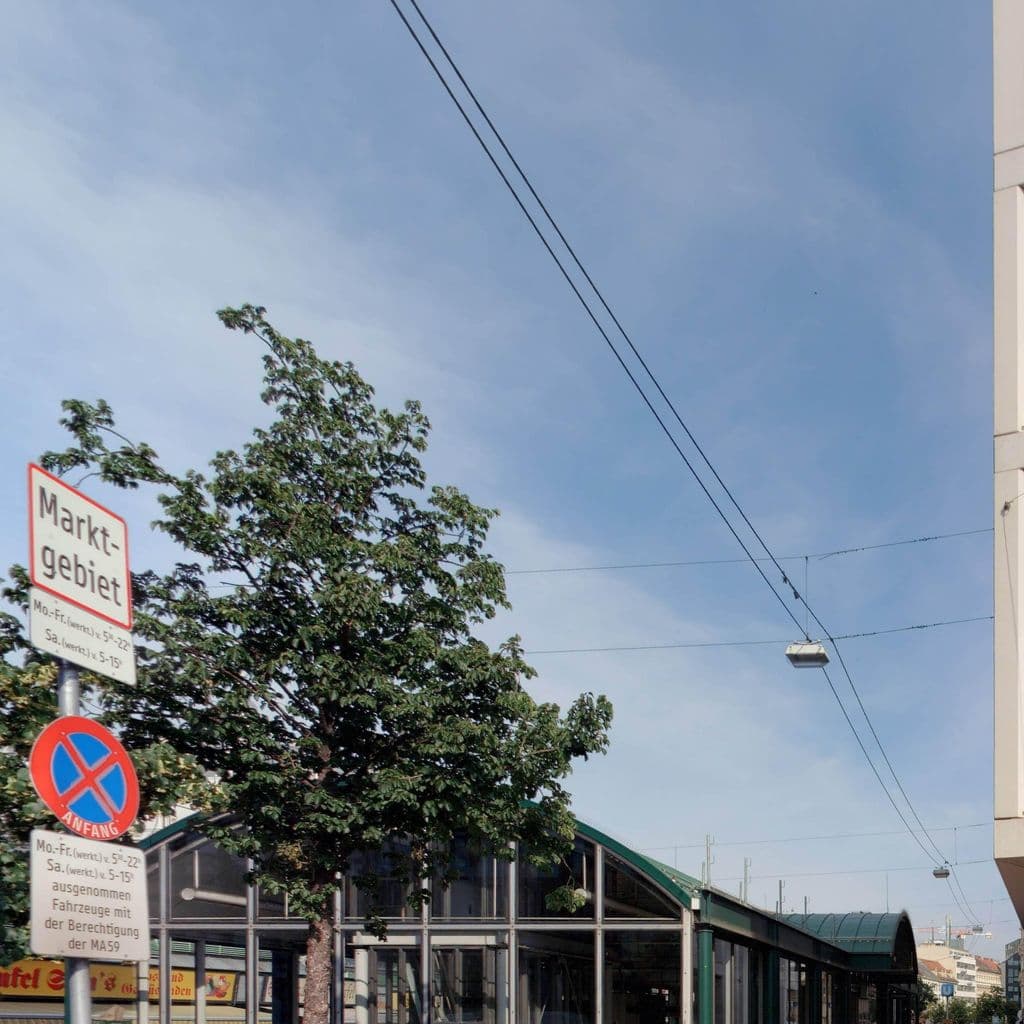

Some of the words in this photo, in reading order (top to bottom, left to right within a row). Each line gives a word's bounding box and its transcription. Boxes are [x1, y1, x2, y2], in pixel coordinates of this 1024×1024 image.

[38, 485, 120, 557] Markt-
[41, 545, 122, 607] gebiet
[45, 628, 61, 646] Sa.
[61, 811, 119, 838] ANFANG
[36, 838, 73, 858] Mo.-Fr.
[47, 858, 65, 873] Sa.
[52, 881, 132, 900] ausgenommen
[52, 898, 111, 918] Fahrzeuge
[114, 906, 132, 919] mit
[44, 917, 64, 930] der
[68, 919, 140, 940] Berechtigung
[68, 939, 88, 951] der
